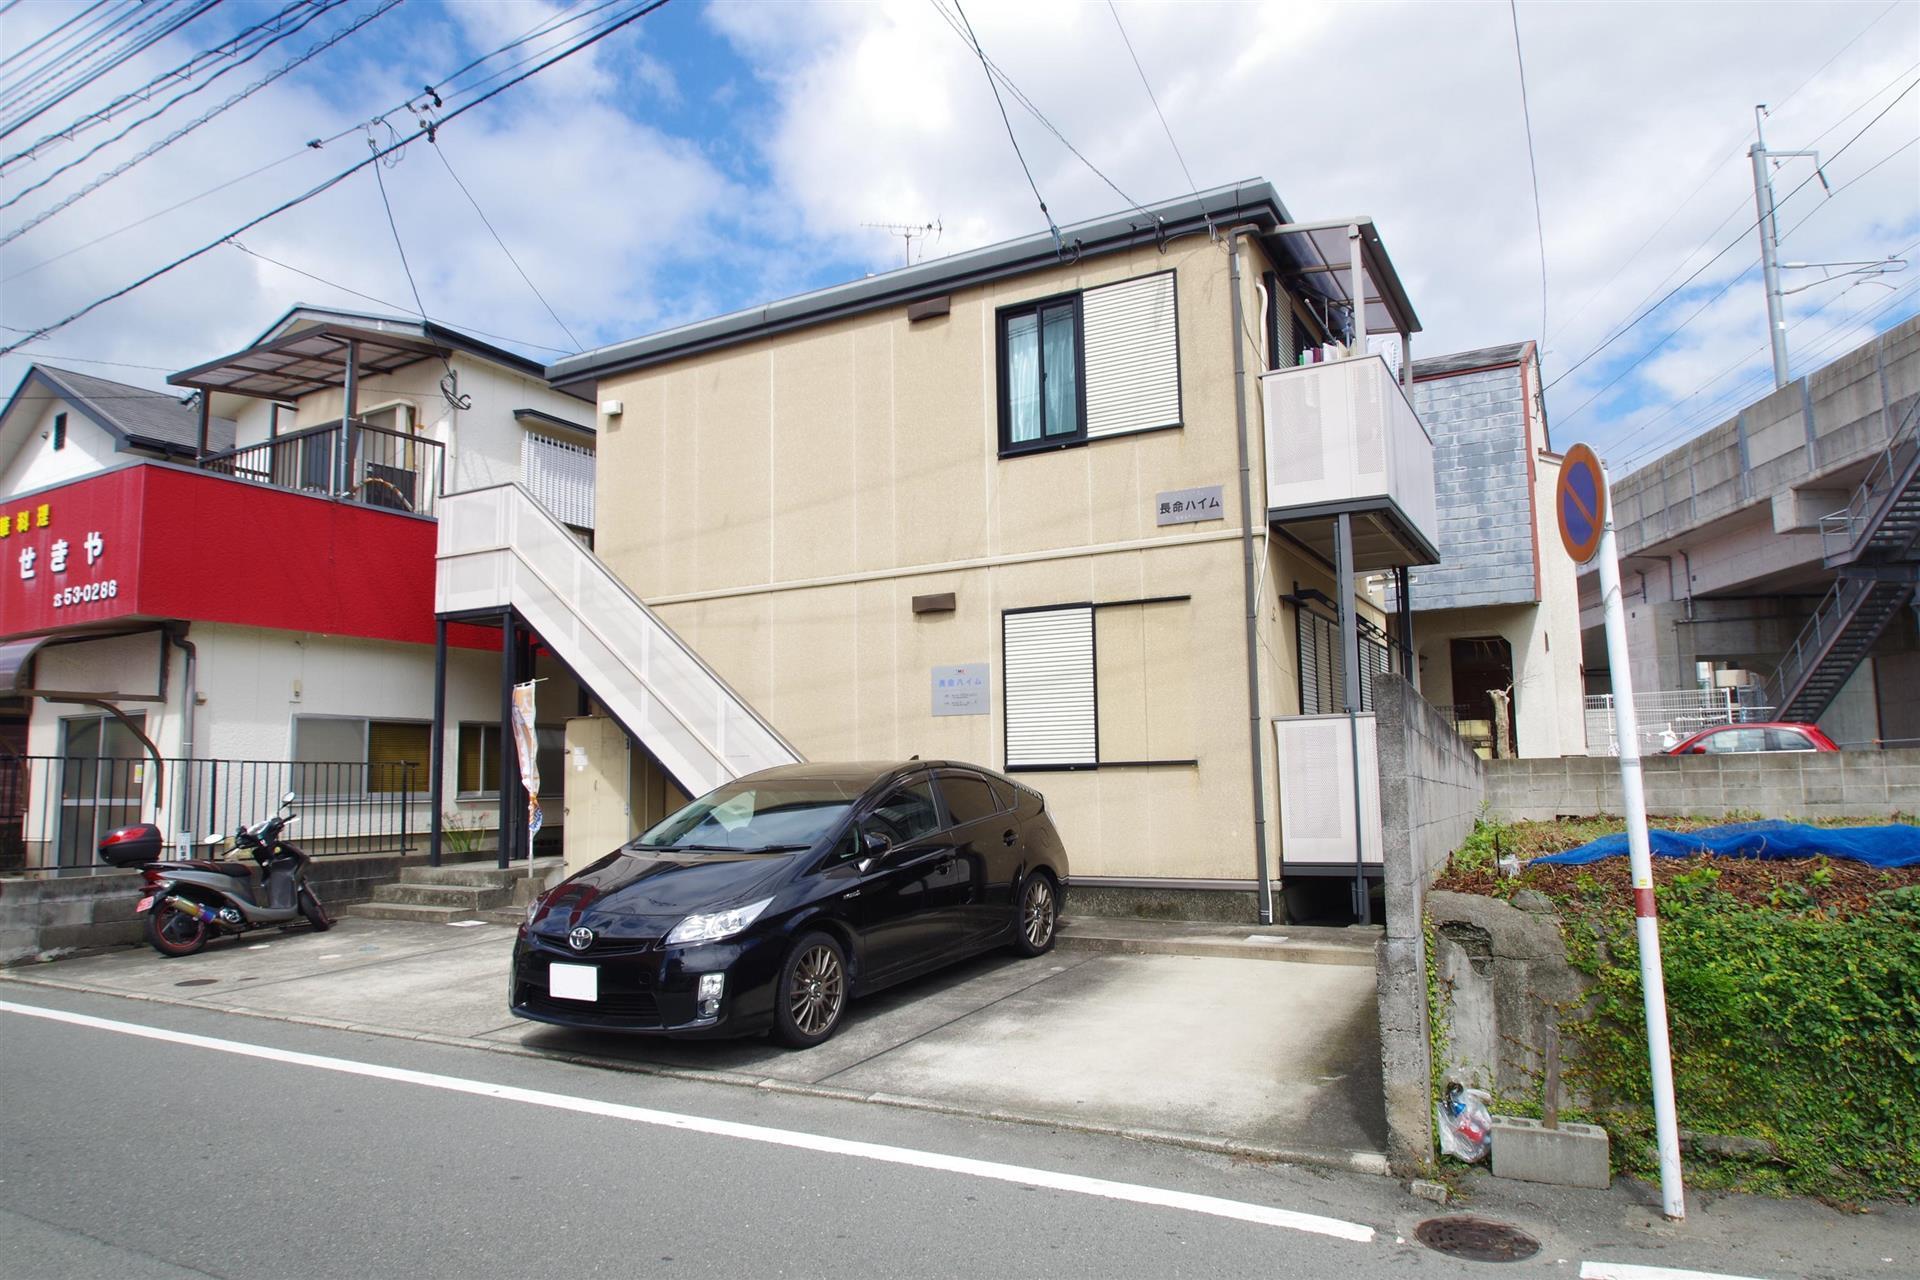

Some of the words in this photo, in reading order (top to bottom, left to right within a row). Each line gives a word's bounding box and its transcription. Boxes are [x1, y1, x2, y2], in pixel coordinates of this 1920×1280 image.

[1160, 497, 1219, 514] 長命ハイム
[19, 532, 103, 579] せきや
[64, 580, 117, 606] 53-0286
